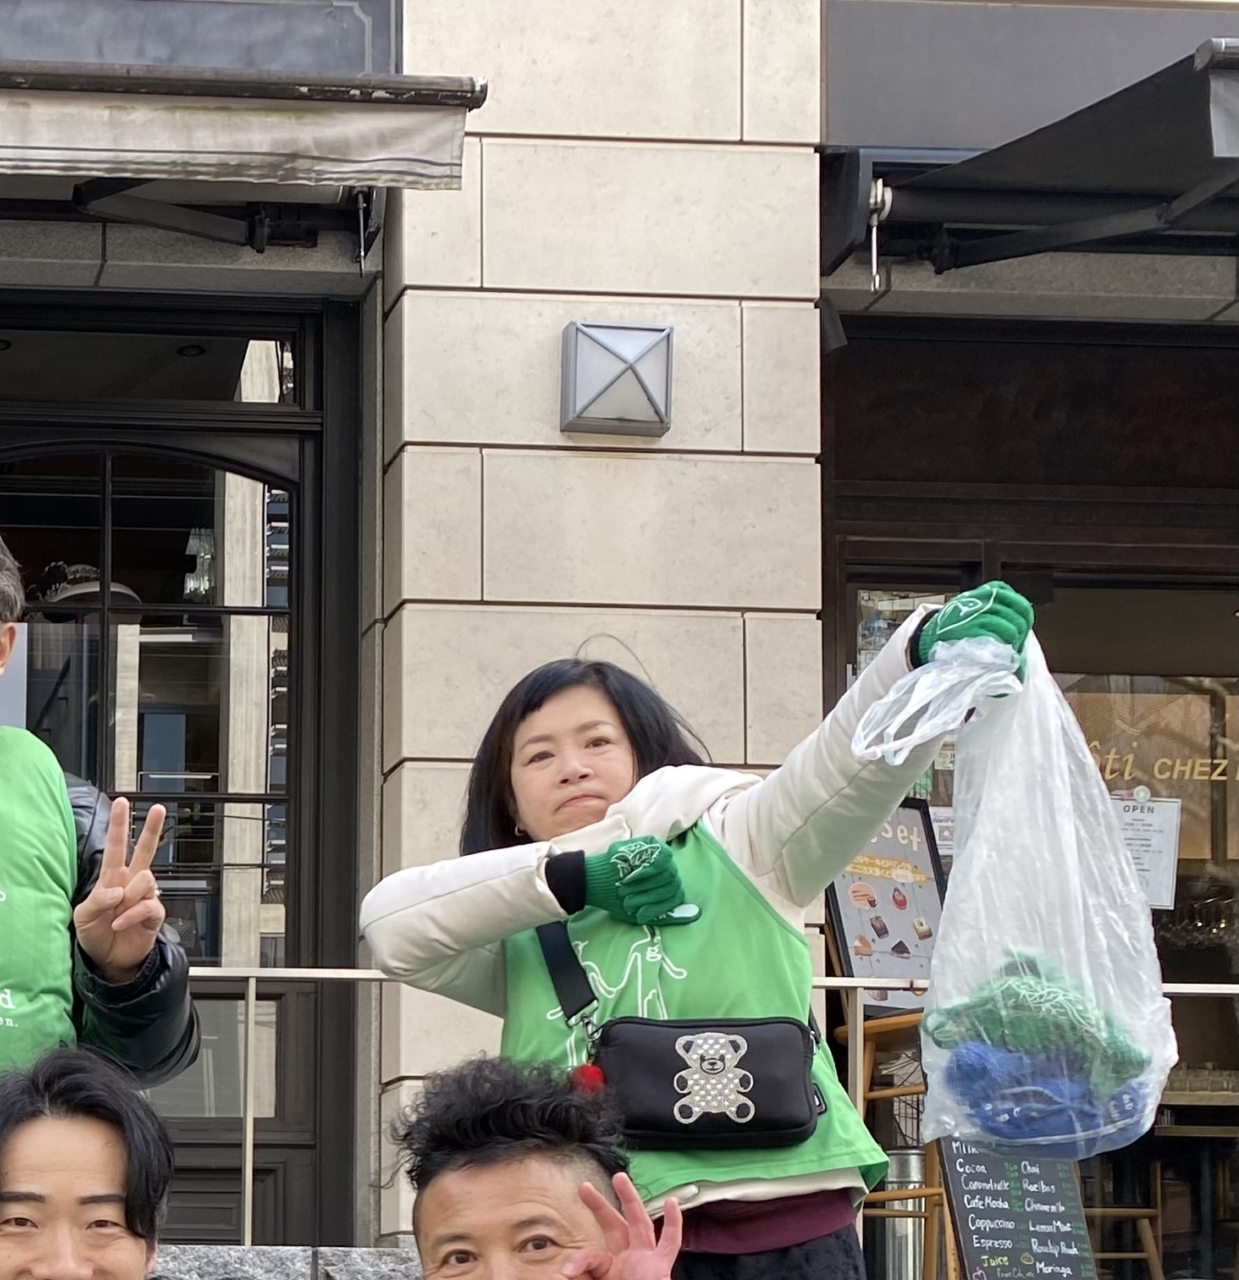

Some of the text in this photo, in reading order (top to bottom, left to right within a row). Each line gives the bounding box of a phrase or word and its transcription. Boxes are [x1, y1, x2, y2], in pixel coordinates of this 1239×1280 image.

[1153, 757, 1229, 780] CHEZ
[1123, 804, 1155, 814] OPEN
[956, 1158, 987, 1174] Cocoa
[972, 1235, 1013, 1251] Espresso
[981, 1255, 1009, 1267] Juice
